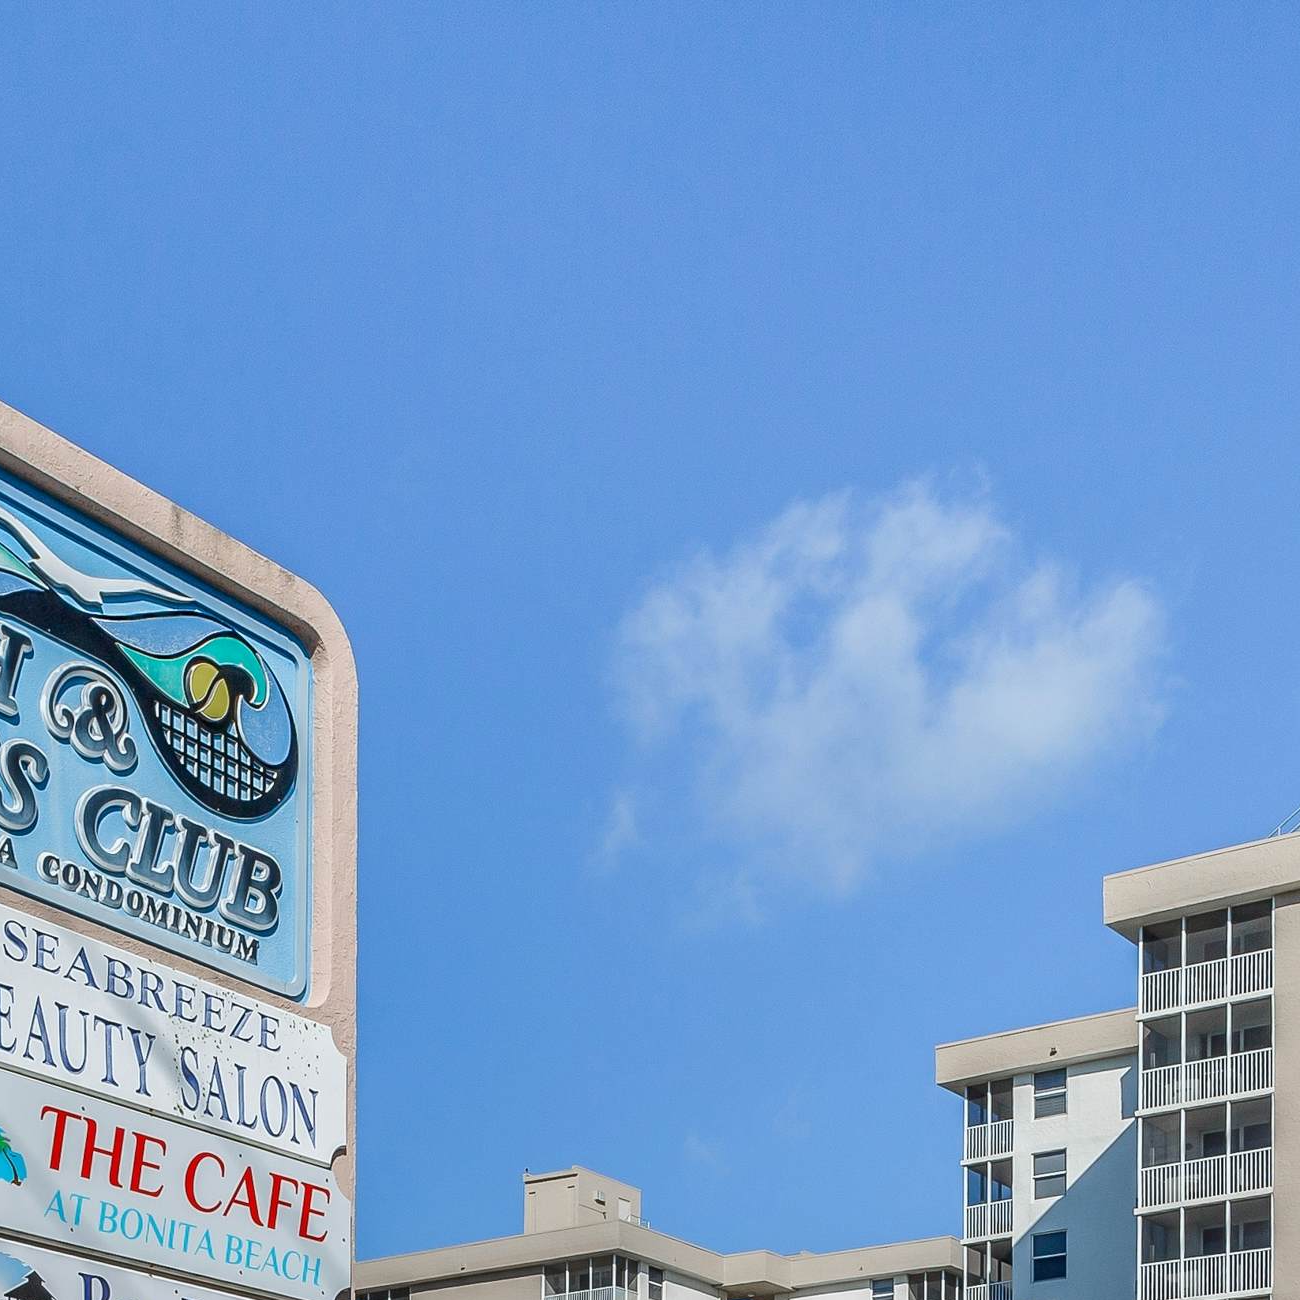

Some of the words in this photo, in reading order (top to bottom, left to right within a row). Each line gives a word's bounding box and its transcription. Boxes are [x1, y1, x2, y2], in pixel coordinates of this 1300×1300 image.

[44, 660, 137, 774] &
[36, 850, 260, 965] CONDOMINIUM
[75, 783, 284, 932] CLUB
[2, 919, 282, 1052] SEABREEZE
[180, 1046, 319, 1150] SALON
[40, 1104, 167, 1198] THE
[183, 1151, 332, 1244] CAFE
[43, 1189, 91, 1228] AT
[98, 1202, 216, 1262] BONITA
[224, 1234, 324, 1288] BEACH
